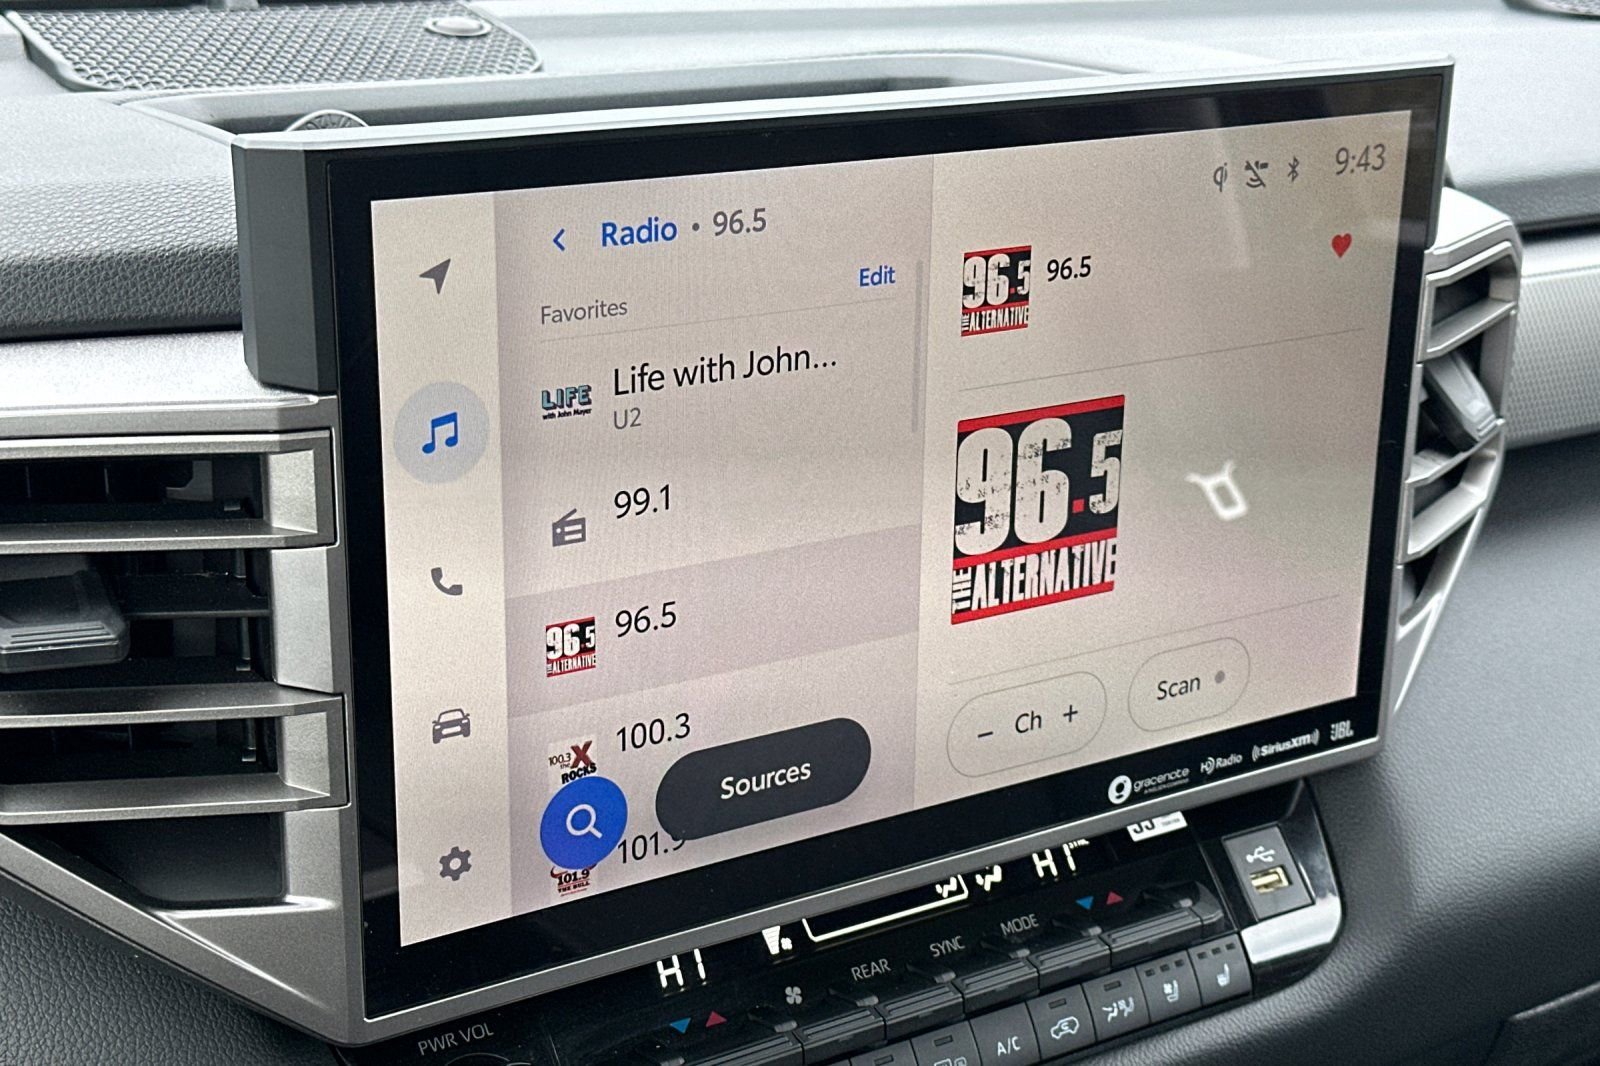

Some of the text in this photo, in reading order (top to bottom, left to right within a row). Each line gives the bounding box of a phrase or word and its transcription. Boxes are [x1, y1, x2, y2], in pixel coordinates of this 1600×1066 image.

[1335, 144, 1386, 175] 9:43
[601, 207, 767, 247] Radio 96.5
[859, 265, 896, 287] Edit
[963, 253, 1030, 309] 96.5
[1047, 255, 1092, 282] 96.5
[540, 299, 628, 325] Favorites
[969, 305, 1029, 332] ALTERNATIVE
[614, 345, 836, 396] Life with John...
[542, 385, 592, 411] LIFE
[613, 407, 642, 430] U2
[954, 417, 1123, 555] 96.5
[614, 484, 670, 519] 99.1
[971, 540, 1117, 611] ALTERNATIVE
[615, 601, 677, 637] 96.5
[546, 623, 595, 660] 96.5
[1156, 675, 1201, 701] Scan
[616, 713, 691, 751] 100.3
[1014, 711, 1043, 734] Ch
[1330, 720, 1354, 741] JBL
[549, 752, 571, 766] 100.3
[1216, 753, 1243, 769] Radio
[561, 762, 597, 784] ROCKS
[720, 762, 811, 799] Sources
[1133, 767, 1190, 793] gracenote
[1032, 848, 1076, 878] HI
[557, 868, 590, 886] 101.9
[1000, 914, 1040, 935] MODE
[929, 935, 966, 957] SYNC
[656, 948, 705, 988] HI
[851, 958, 892, 981] REAR
[417, 1022, 494, 1056] PWR VOL
[997, 1036, 1021, 1056] A/C
